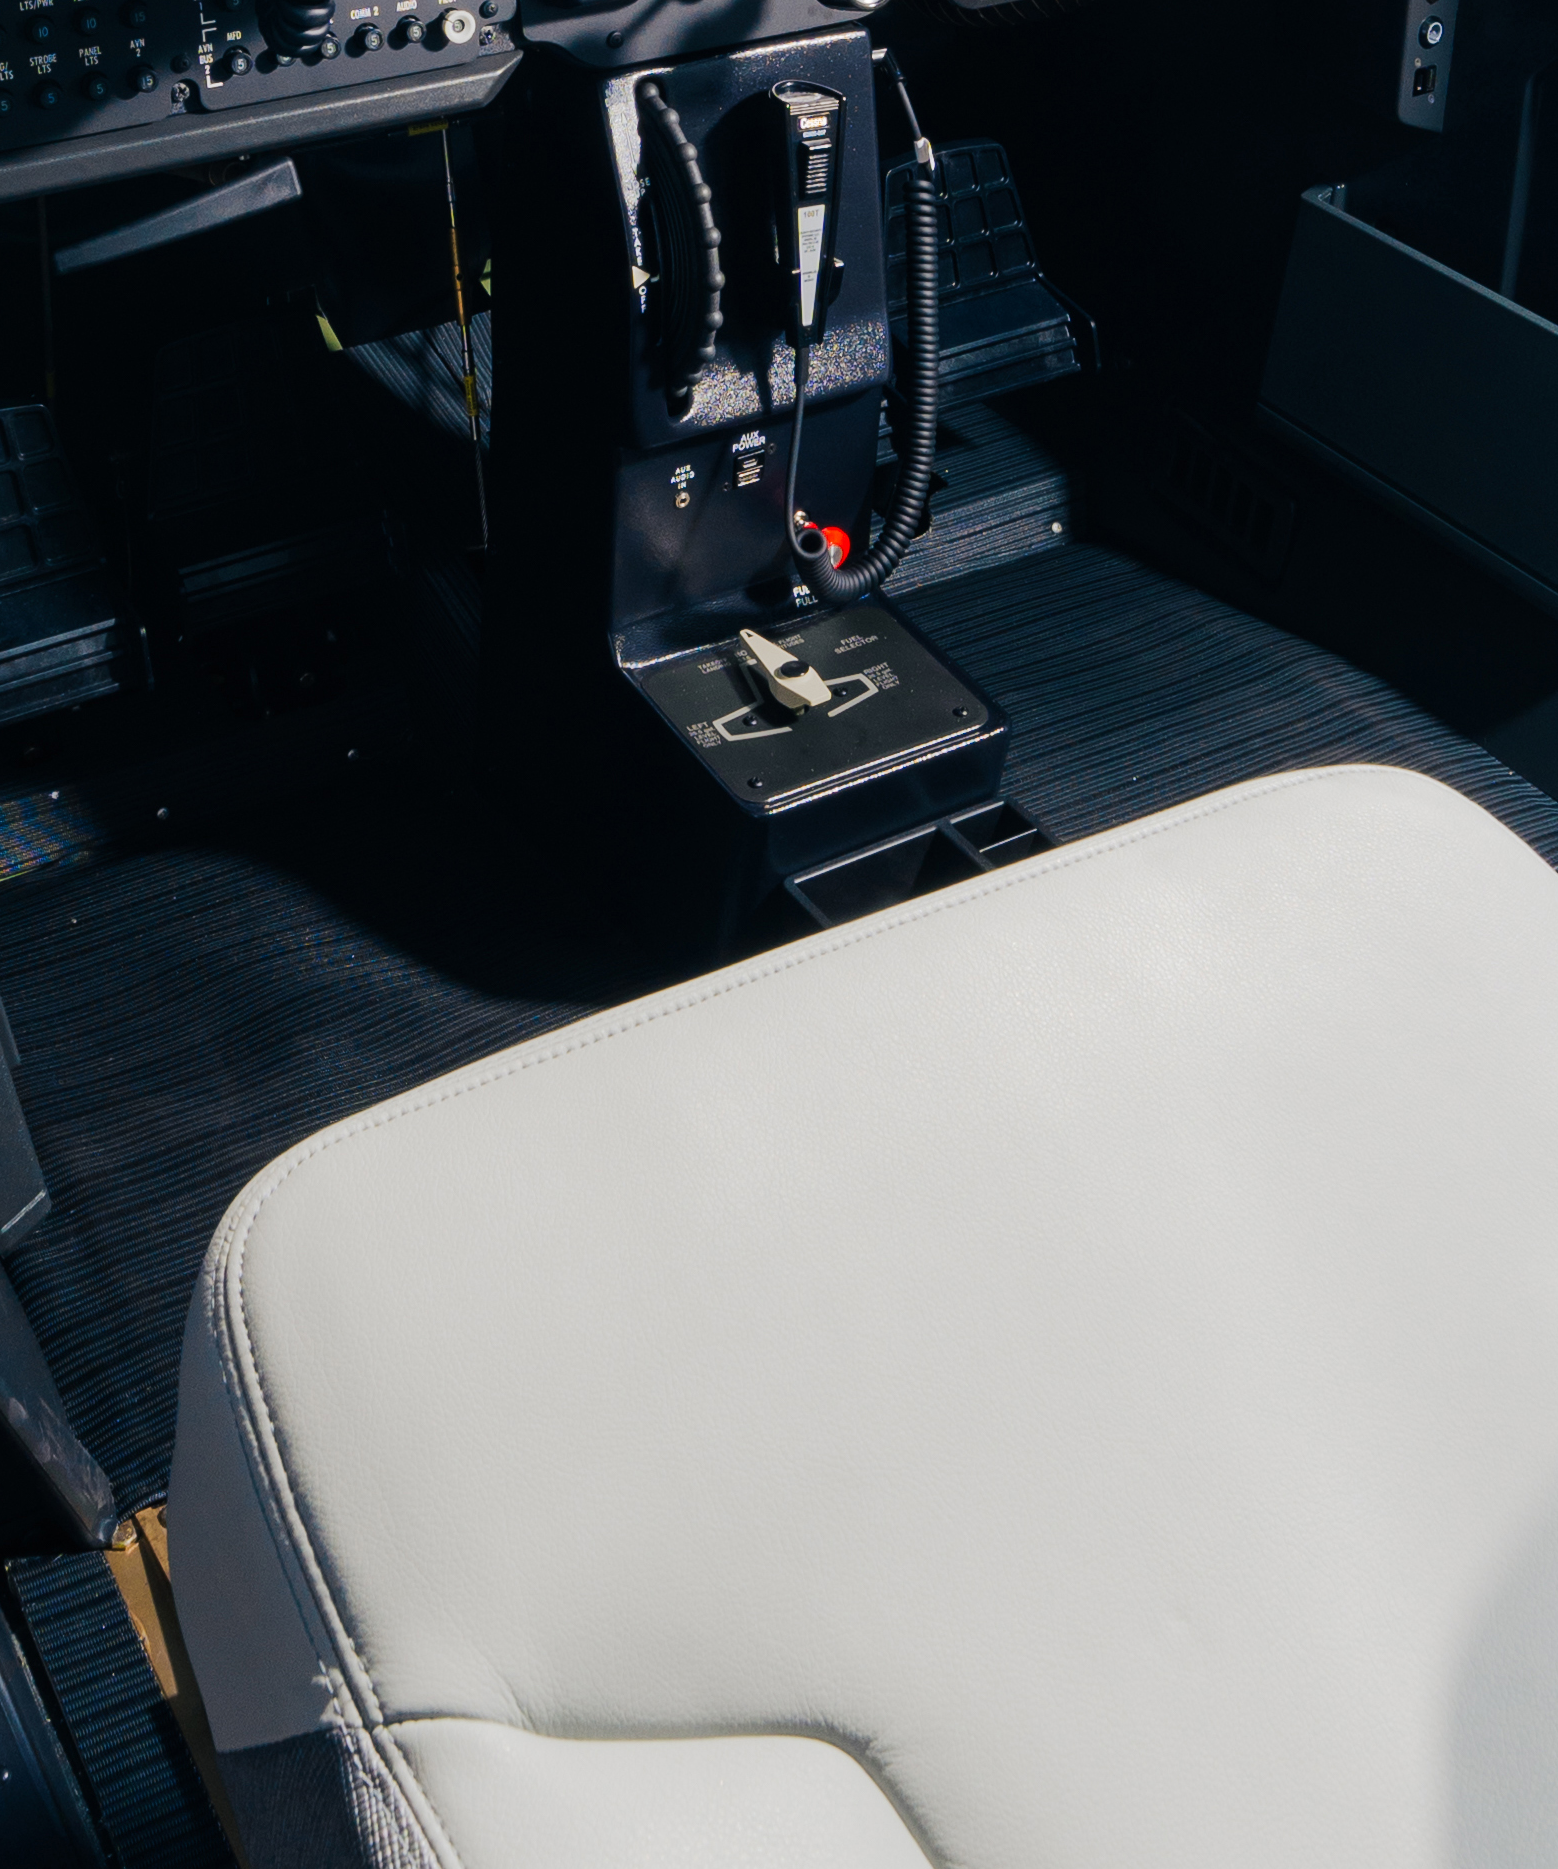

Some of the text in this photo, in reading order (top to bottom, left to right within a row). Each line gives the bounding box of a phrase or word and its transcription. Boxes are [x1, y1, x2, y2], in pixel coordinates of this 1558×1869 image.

[397, 0, 417, 11] AUDIO
[227, 31, 241, 41] MFD
[130, 39, 145, 49] AVN
[198, 43, 213, 53] AVN
[79, 46, 102, 57] PANEL
[30, 54, 57, 66] STROBE
[85, 56, 98, 66] LTS
[200, 54, 213, 64] BUS
[38, 64, 51, 74] LTS
[0, 70, 14, 80] LTS
[740, 431, 759, 442] AUX
[733, 436, 765, 453] POWER
[796, 596, 818, 607] PULL
[834, 635, 878, 654] SELECTOR
[841, 635, 863, 646] FUEL
[863, 662, 888, 675] RIGHT
[686, 722, 709, 731] LEFT
